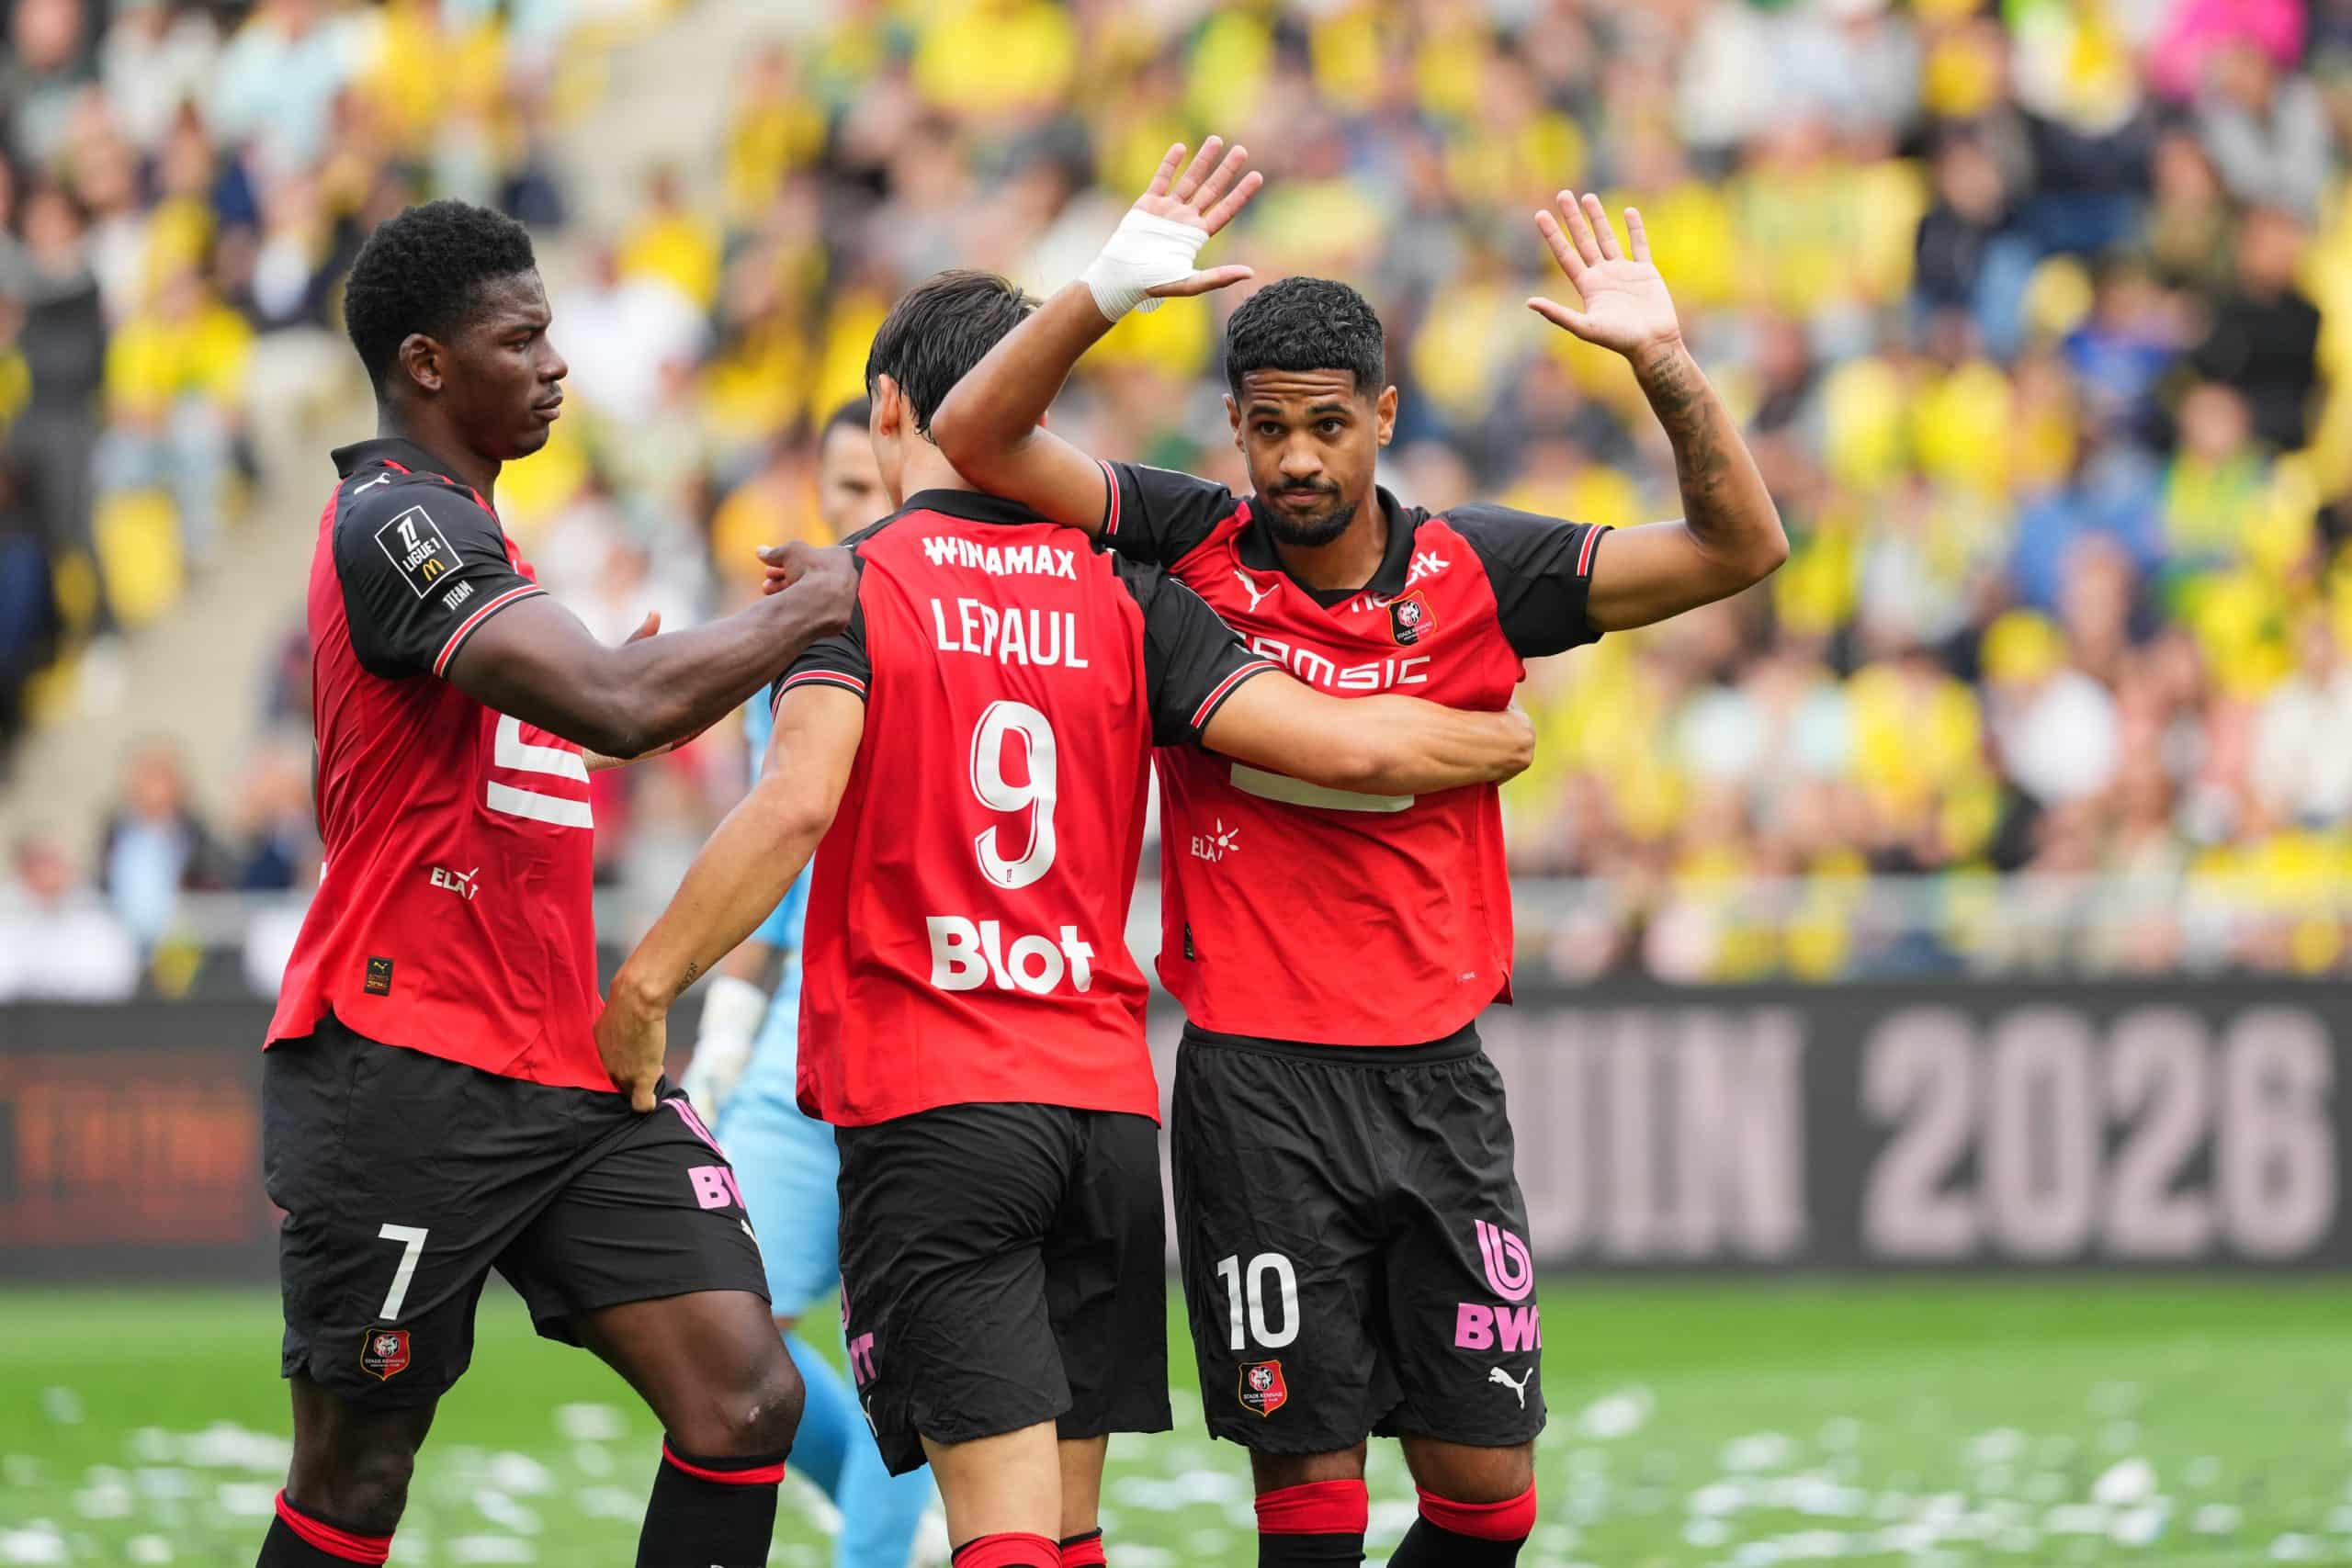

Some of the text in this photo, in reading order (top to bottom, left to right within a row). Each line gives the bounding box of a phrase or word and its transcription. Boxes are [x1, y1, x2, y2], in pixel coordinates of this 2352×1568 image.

[922, 536, 1077, 581] WINAMAX
[931, 598, 1089, 669] LEPAUL
[970, 700, 1057, 890] 9
[926, 916, 1095, 995] Blot
[1860, 1003, 2337, 1259] 2026
[378, 1224, 429, 1321] 7
[1217, 1252, 1300, 1350] 10
[1455, 1303, 1542, 1352] BW
